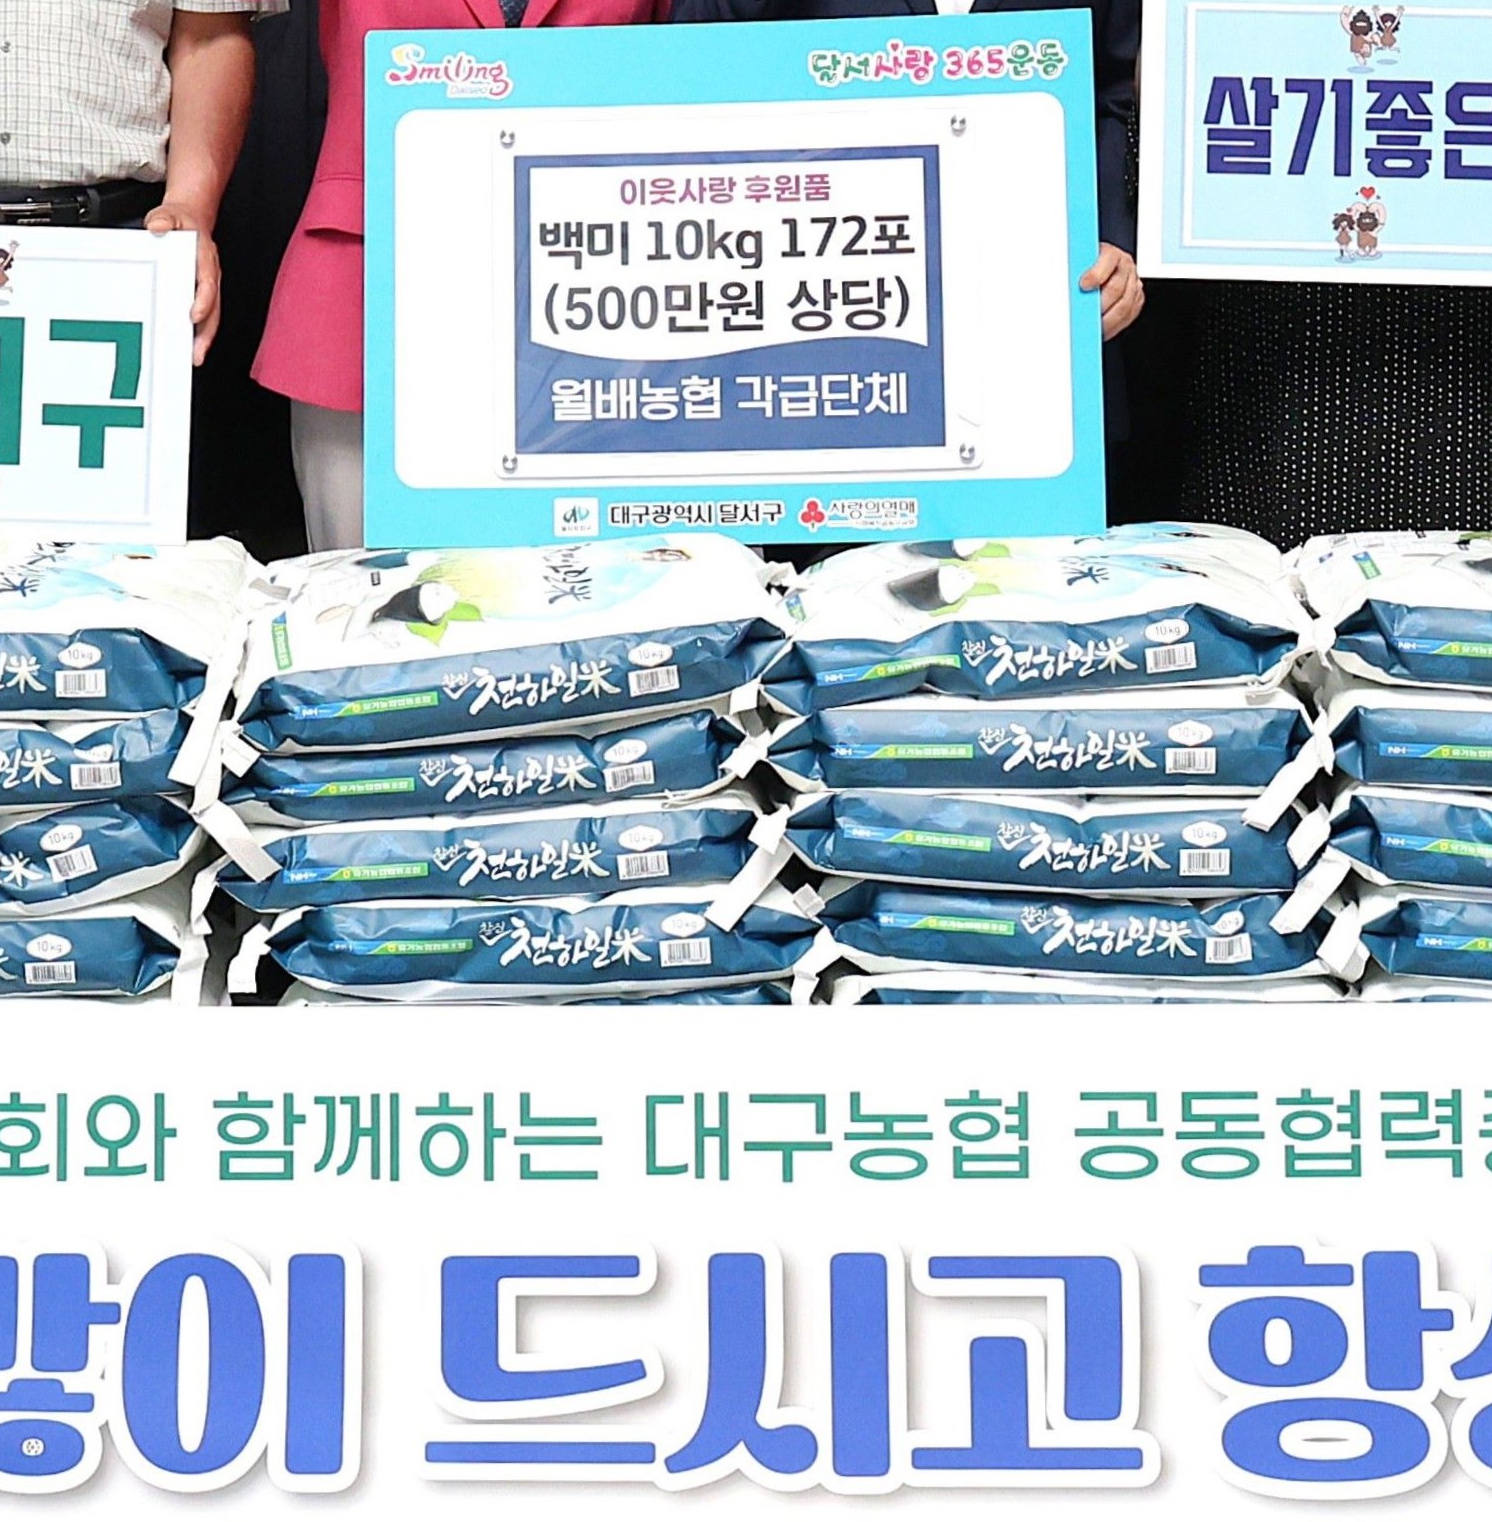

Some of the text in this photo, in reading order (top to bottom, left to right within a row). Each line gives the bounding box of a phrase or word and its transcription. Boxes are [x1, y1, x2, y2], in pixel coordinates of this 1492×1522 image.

[389, 45, 509, 96] Smiling
[811, 42, 1064, 83] 달서사랑 365운동
[619, 173, 832, 205] 이웃사랑 후원품
[539, 214, 916, 270] 백미 10kg 172포
[544, 275, 910, 335] (500만원 상당)
[551, 371, 909, 423] 월배농협 각급단체
[610, 501, 782, 526] 대구광역시 달서구
[829, 500, 915, 520] 사랑의열매
[1153, 624, 1182, 637] 10kg
[67, 648, 95, 661] 10kg
[637, 648, 666, 660] 10kg
[985, 636, 1138, 685] 천하일米
[468, 659, 622, 715] 천하일米
[612, 744, 641, 758] 10kg
[1003, 721, 1156, 771] 천하일米
[1176, 725, 1205, 739] 10kg
[445, 750, 597, 802] 천하일米
[48, 830, 77, 845] 10kg
[627, 831, 655, 845] 10kg
[1018, 823, 1171, 873] 천하일米
[1190, 827, 1218, 842] 10kg
[459, 841, 609, 884] 천하일米
[500, 916, 653, 967] 천하일米
[671, 917, 698, 931] 10kg
[1042, 905, 1198, 958] 천하일米
[36, 939, 64, 954] 10kg
[215, 1084, 603, 1184] 함께하는
[645, 1082, 1030, 1184] 대구농협
[425, 1248, 1143, 1481] 드시고
